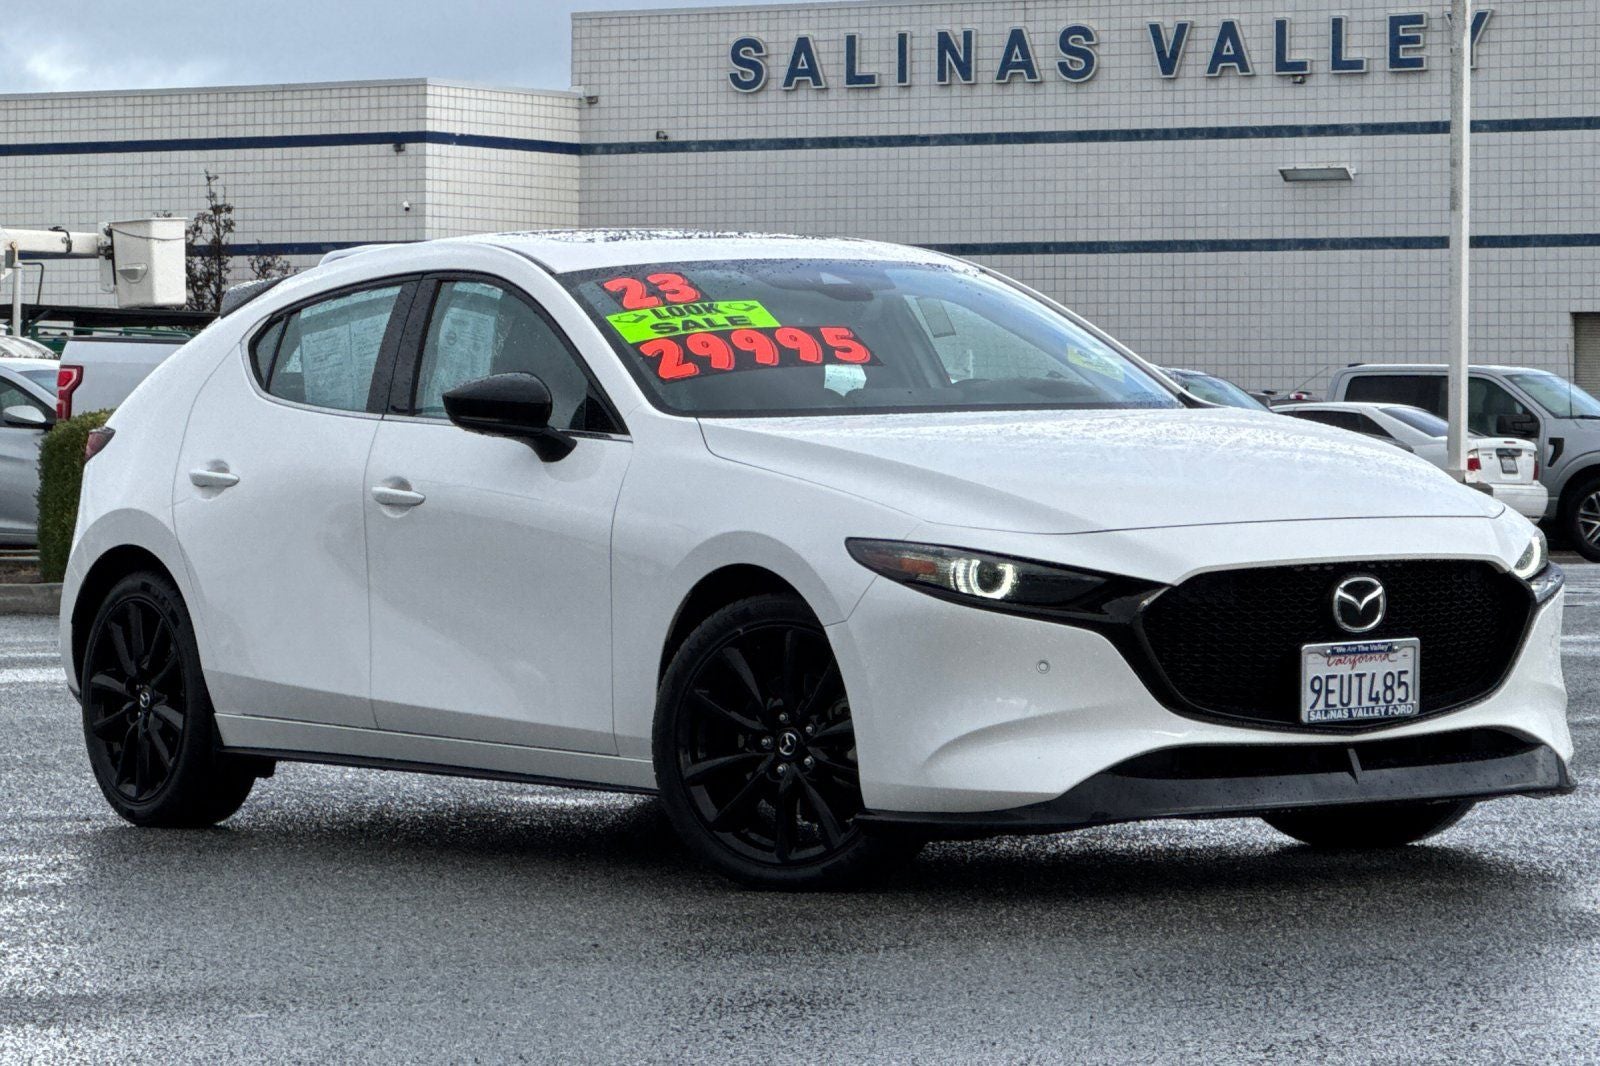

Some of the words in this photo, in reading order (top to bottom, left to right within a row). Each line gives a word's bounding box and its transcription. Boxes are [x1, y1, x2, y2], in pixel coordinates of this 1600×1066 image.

[729, 23, 1098, 92] SALINAS
[603, 273, 701, 310] 23
[650, 303, 721, 320] LOOK
[651, 315, 753, 335] SALE
[640, 327, 870, 380] 29995
[1327, 653, 1397, 670] California
[1309, 670, 1409, 710] 9EUT485
[1309, 709, 1349, 721] SALINAS
[1352, 705, 1386, 717] VALLEY
[1388, 704, 1413, 715] FORD
